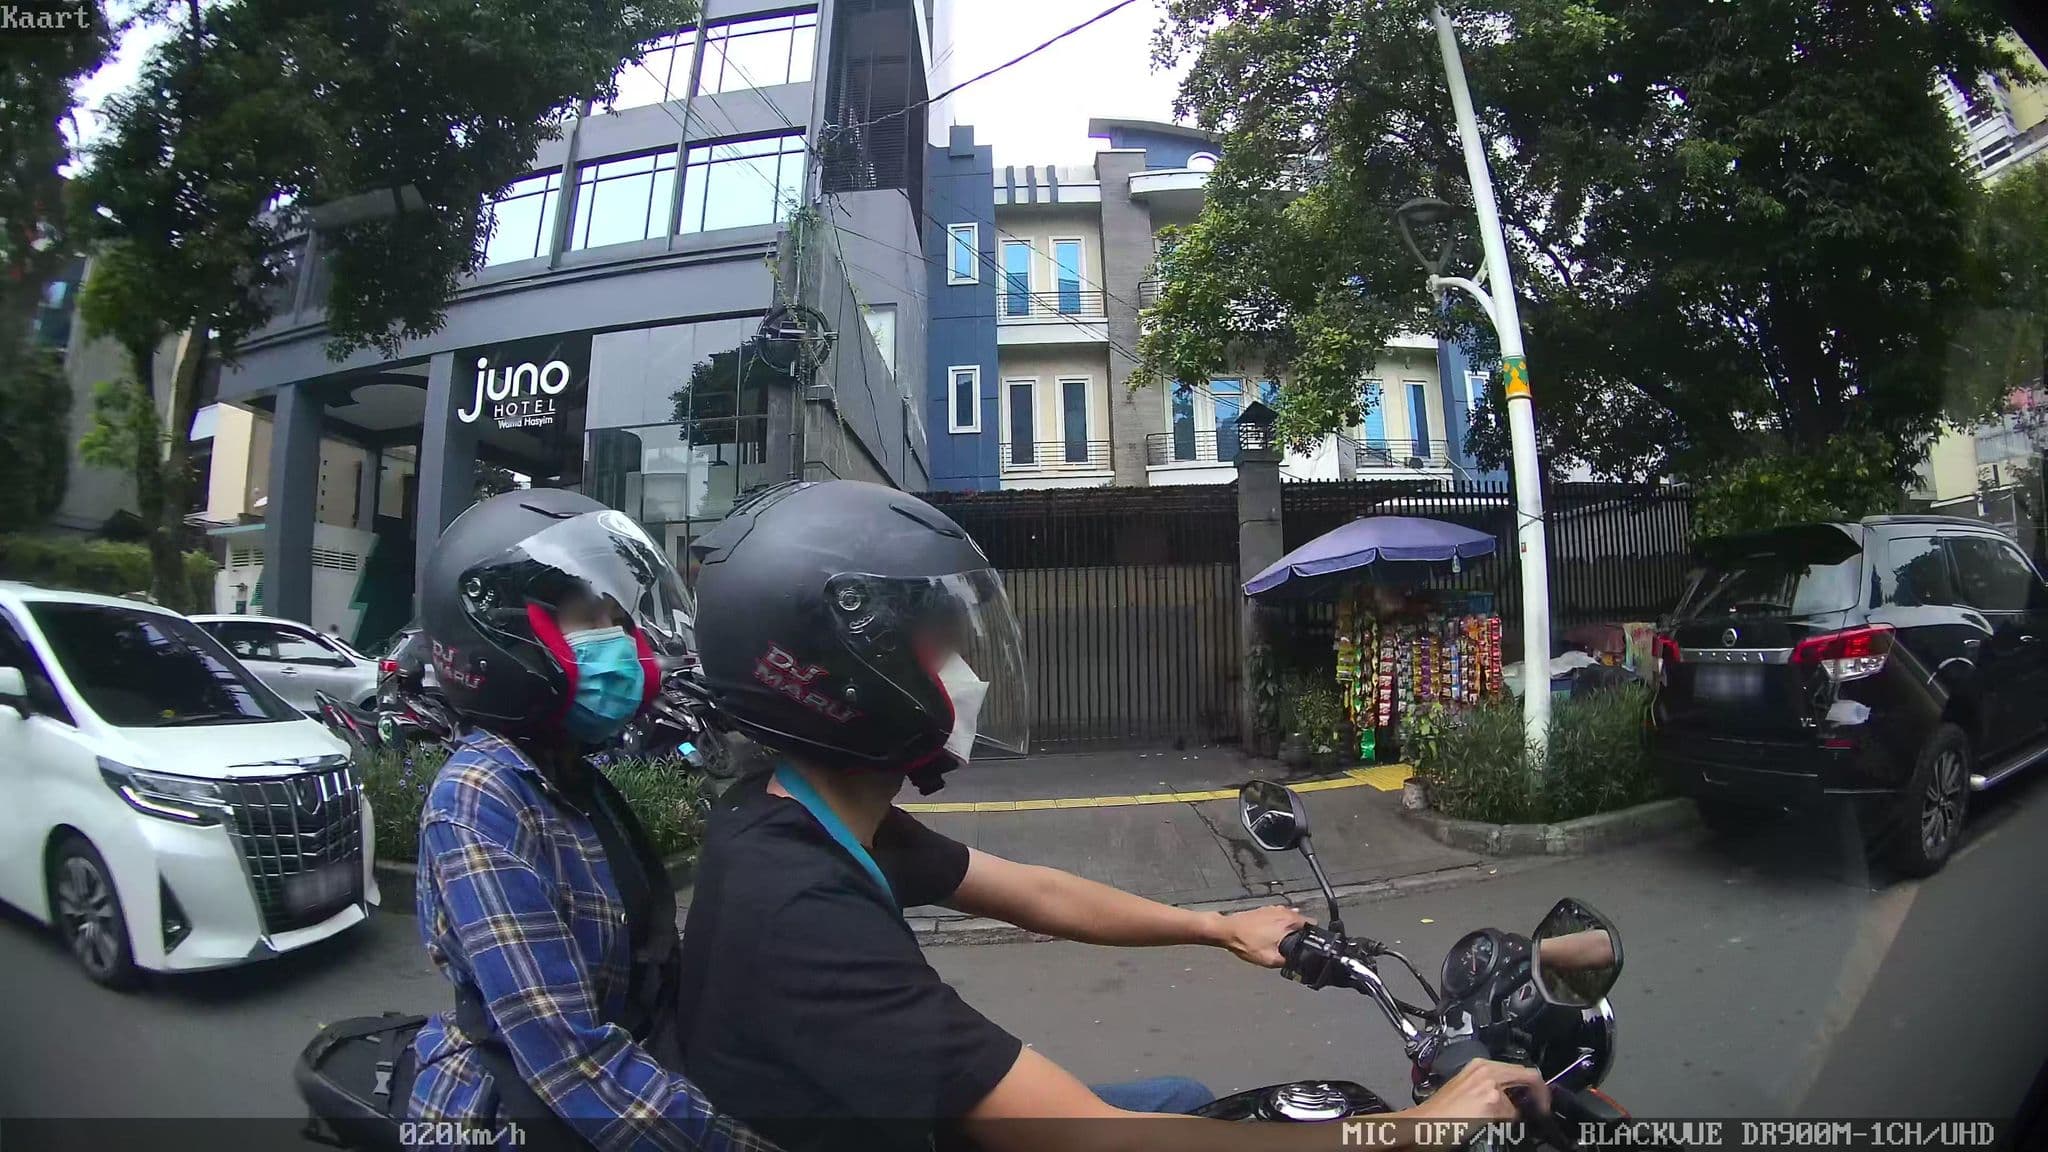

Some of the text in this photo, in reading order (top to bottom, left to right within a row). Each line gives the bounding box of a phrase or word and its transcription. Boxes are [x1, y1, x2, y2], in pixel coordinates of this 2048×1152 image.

[458, 357, 570, 423] juno
[494, 399, 556, 418] HOTEL
[765, 646, 820, 681] DJ
